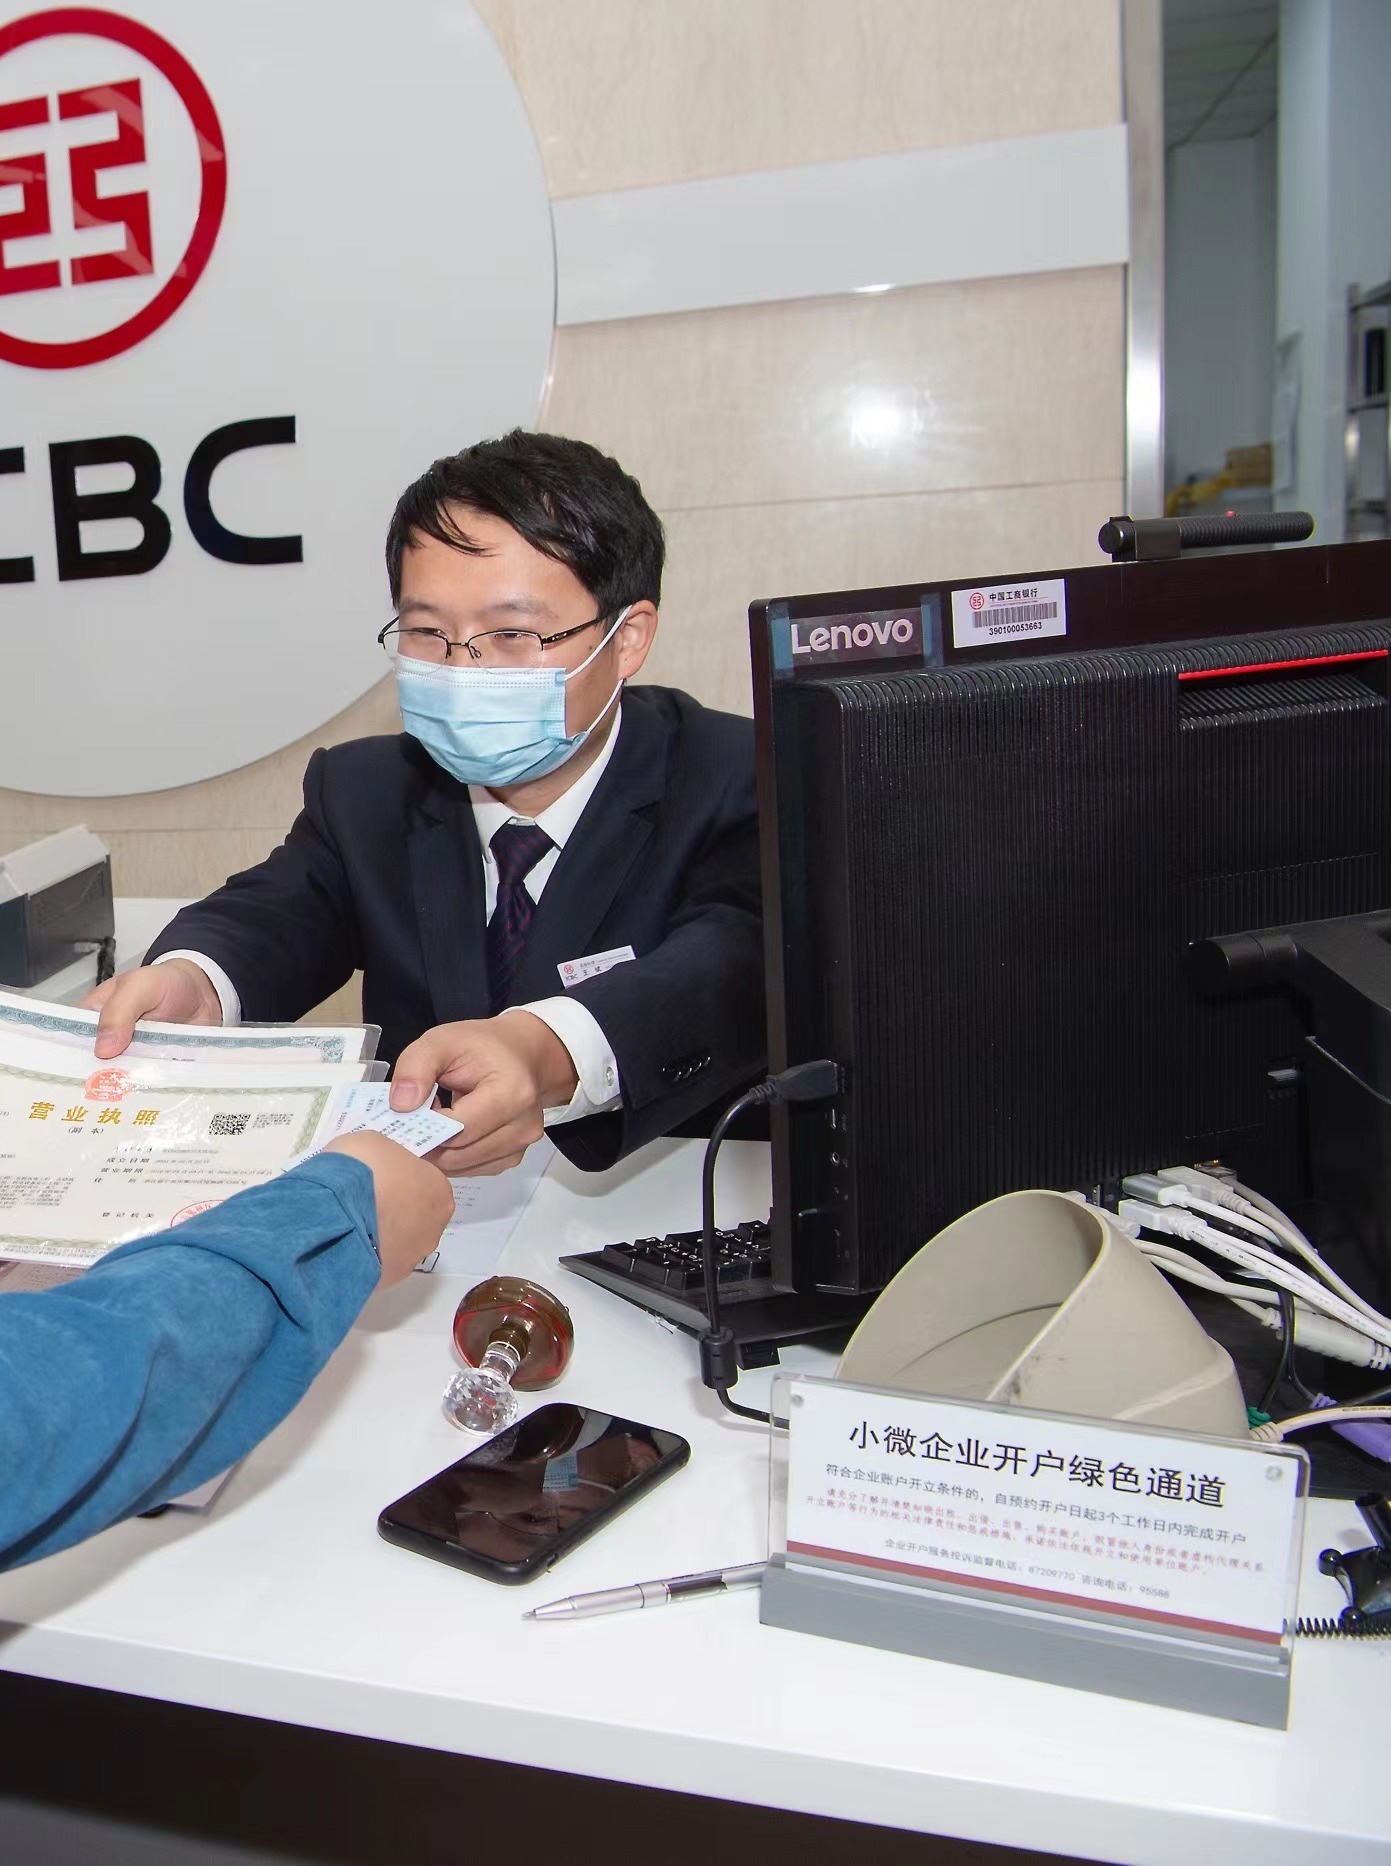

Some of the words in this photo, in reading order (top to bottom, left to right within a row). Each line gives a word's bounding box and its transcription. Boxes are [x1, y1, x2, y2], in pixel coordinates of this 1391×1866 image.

[989, 588, 1038, 601] 中国工商银行
[791, 618, 914, 654] Lenovo
[989, 621, 1043, 636] 390100053663
[28, 1101, 161, 1127] 营业执照
[848, 1420, 1227, 1509] 小微企业开户绿色通道
